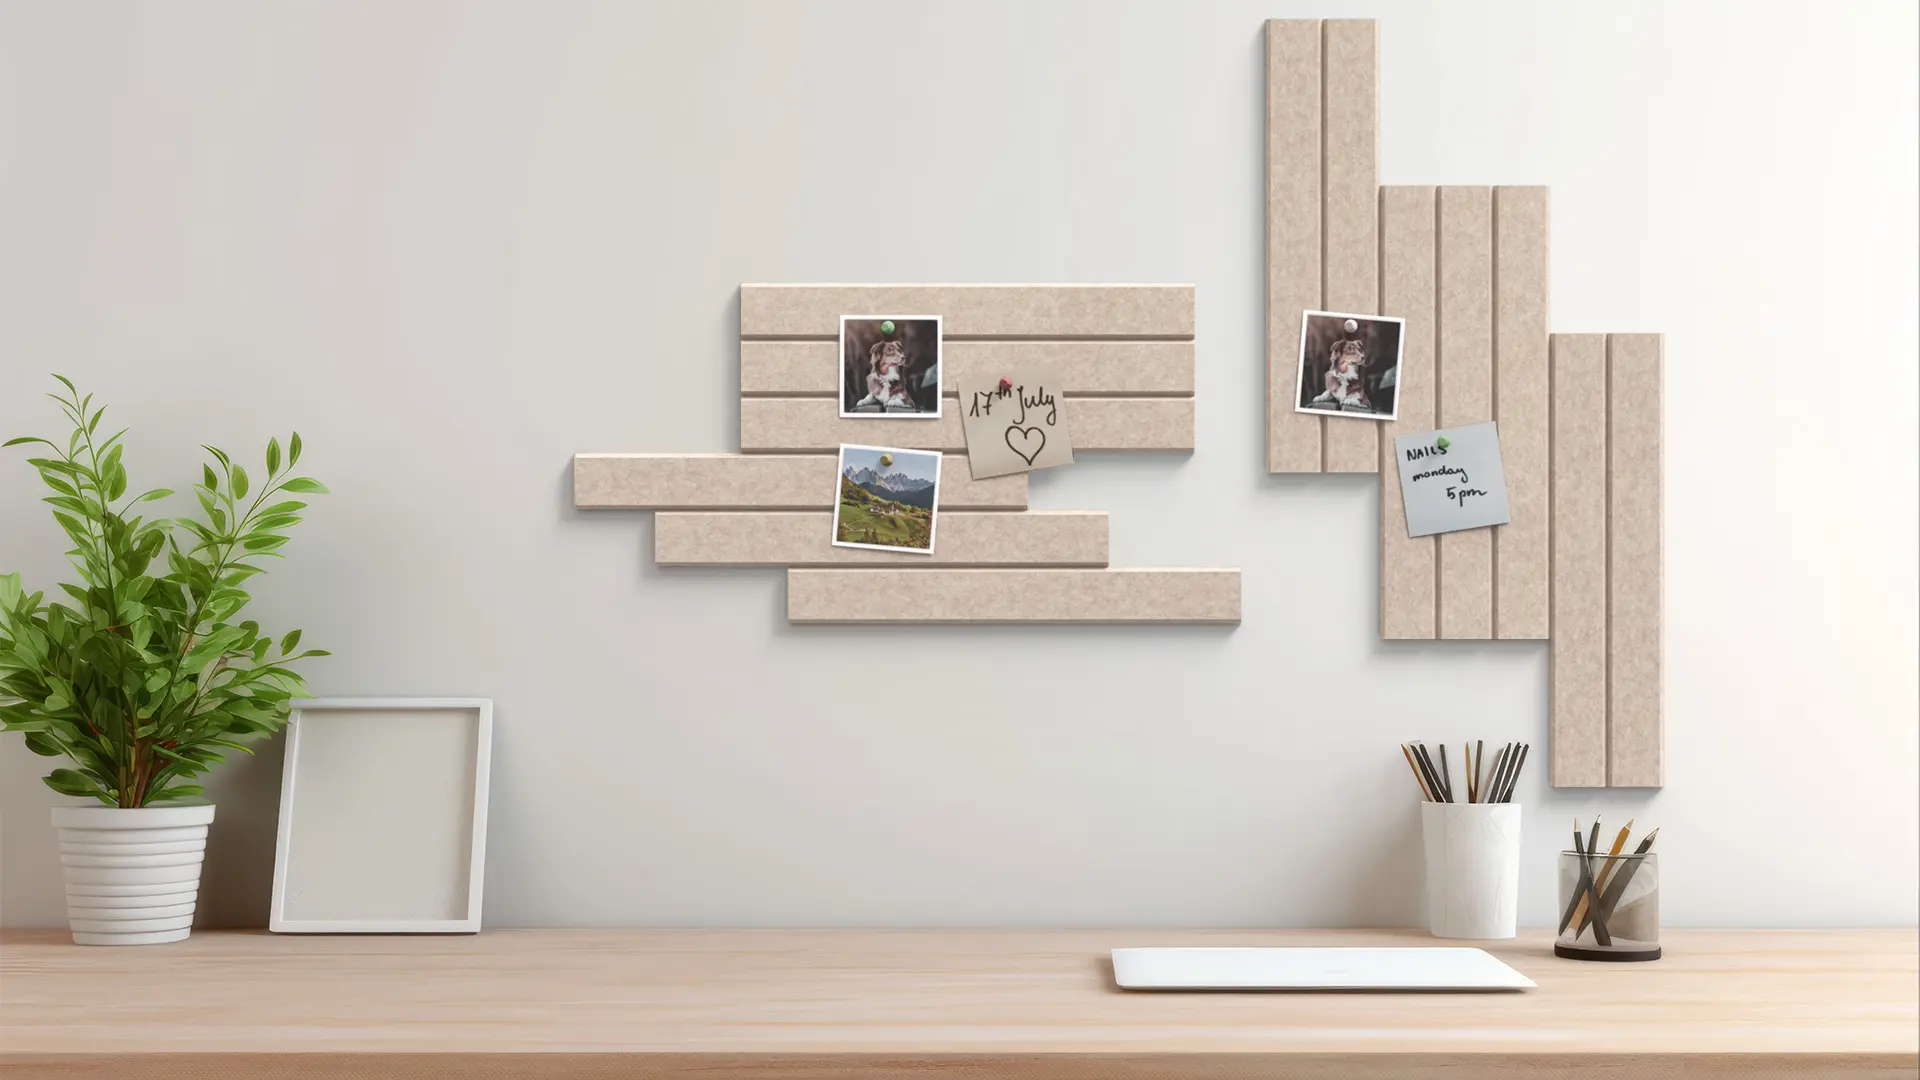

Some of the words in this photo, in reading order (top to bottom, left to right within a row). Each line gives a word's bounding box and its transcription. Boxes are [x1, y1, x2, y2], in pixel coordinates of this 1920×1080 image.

[1013, 385, 1056, 426] July
[1406, 446, 1447, 461] NAILS
[1413, 465, 1469, 484] monday
